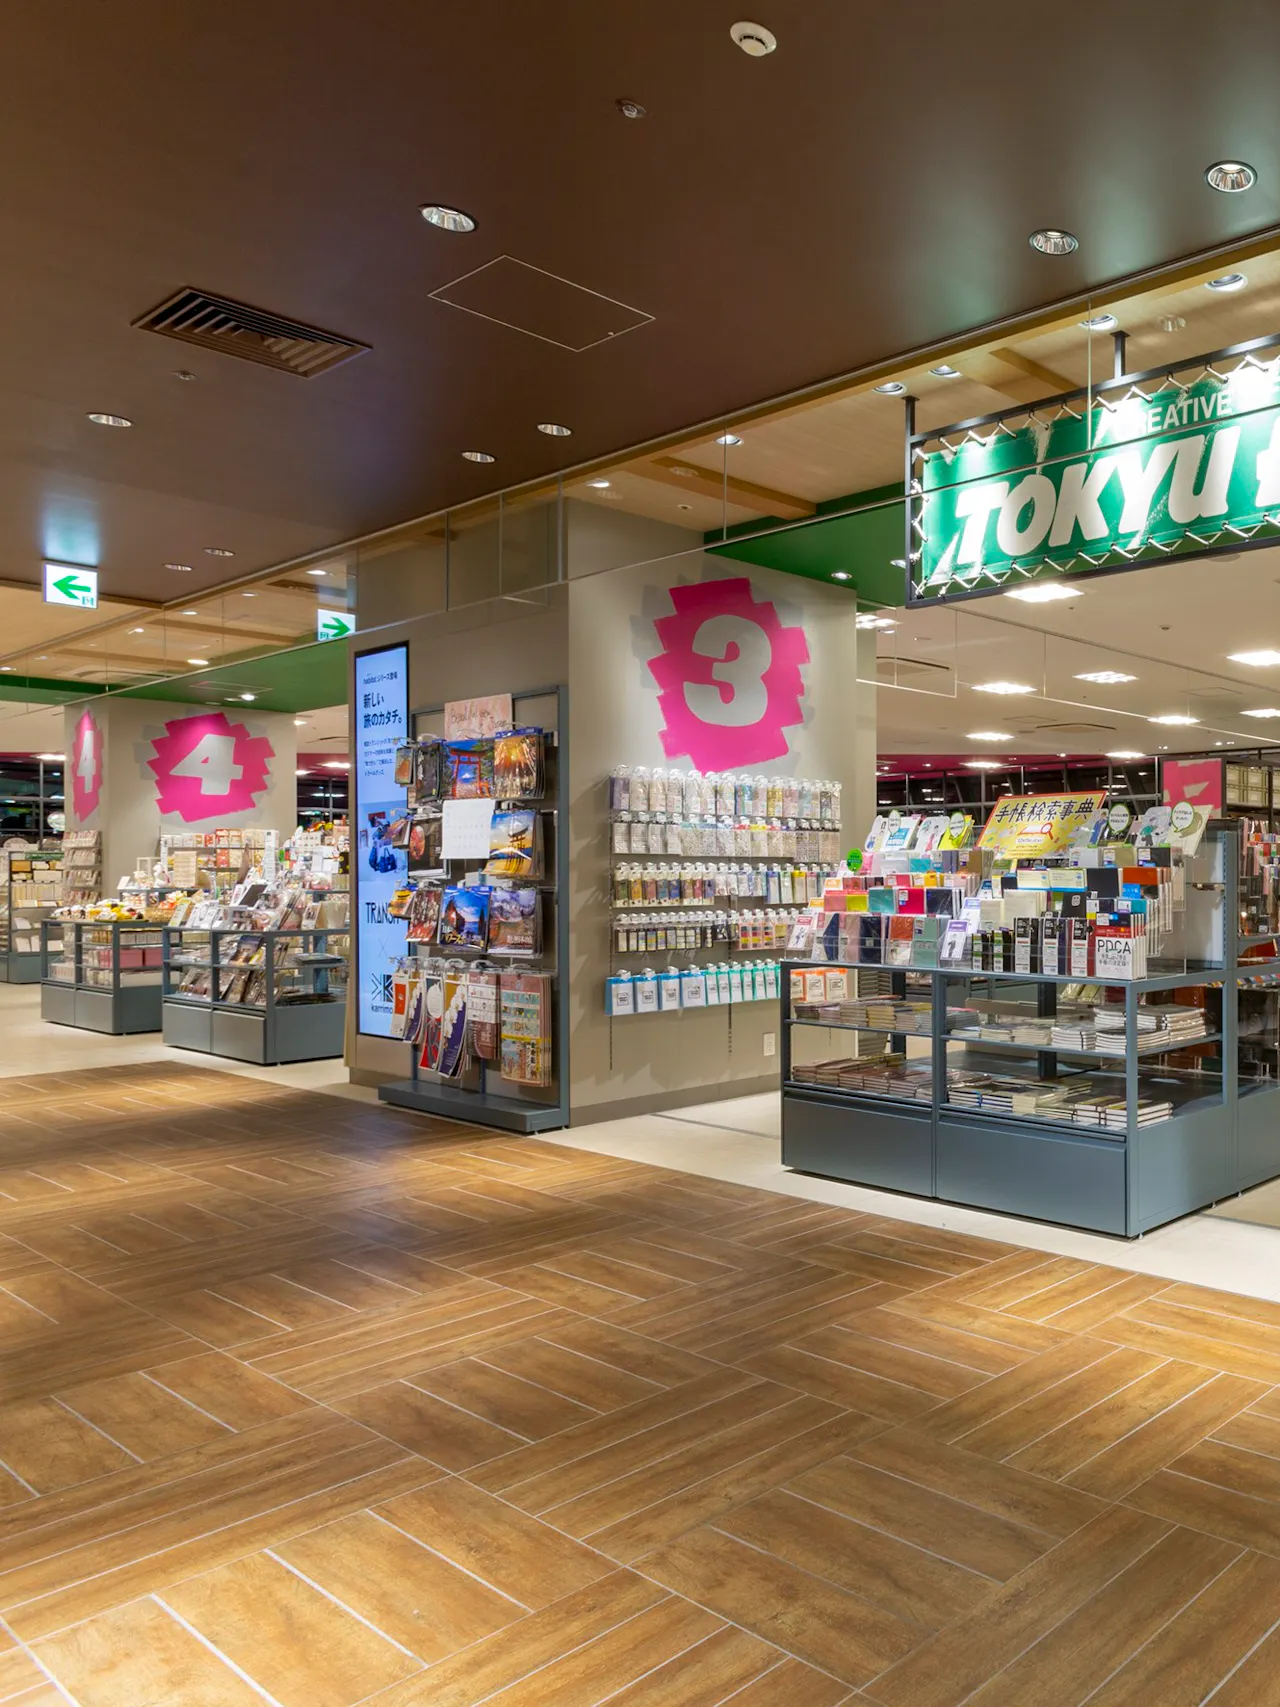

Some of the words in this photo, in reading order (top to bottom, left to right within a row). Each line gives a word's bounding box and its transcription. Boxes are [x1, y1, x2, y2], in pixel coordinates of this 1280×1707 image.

[1108, 391, 1234, 441] EATIVE
[955, 424, 1240, 565] TOKYU
[683, 614, 773, 727] 3
[363, 692, 385, 709] 新しい
[363, 709, 403, 729] 旅のカタチ。
[169, 733, 244, 796] 4
[995, 797, 1095, 824] 手帳検索事典
[1097, 939, 1131, 954] PDCA
[371, 1003, 393, 1013] karrimo
